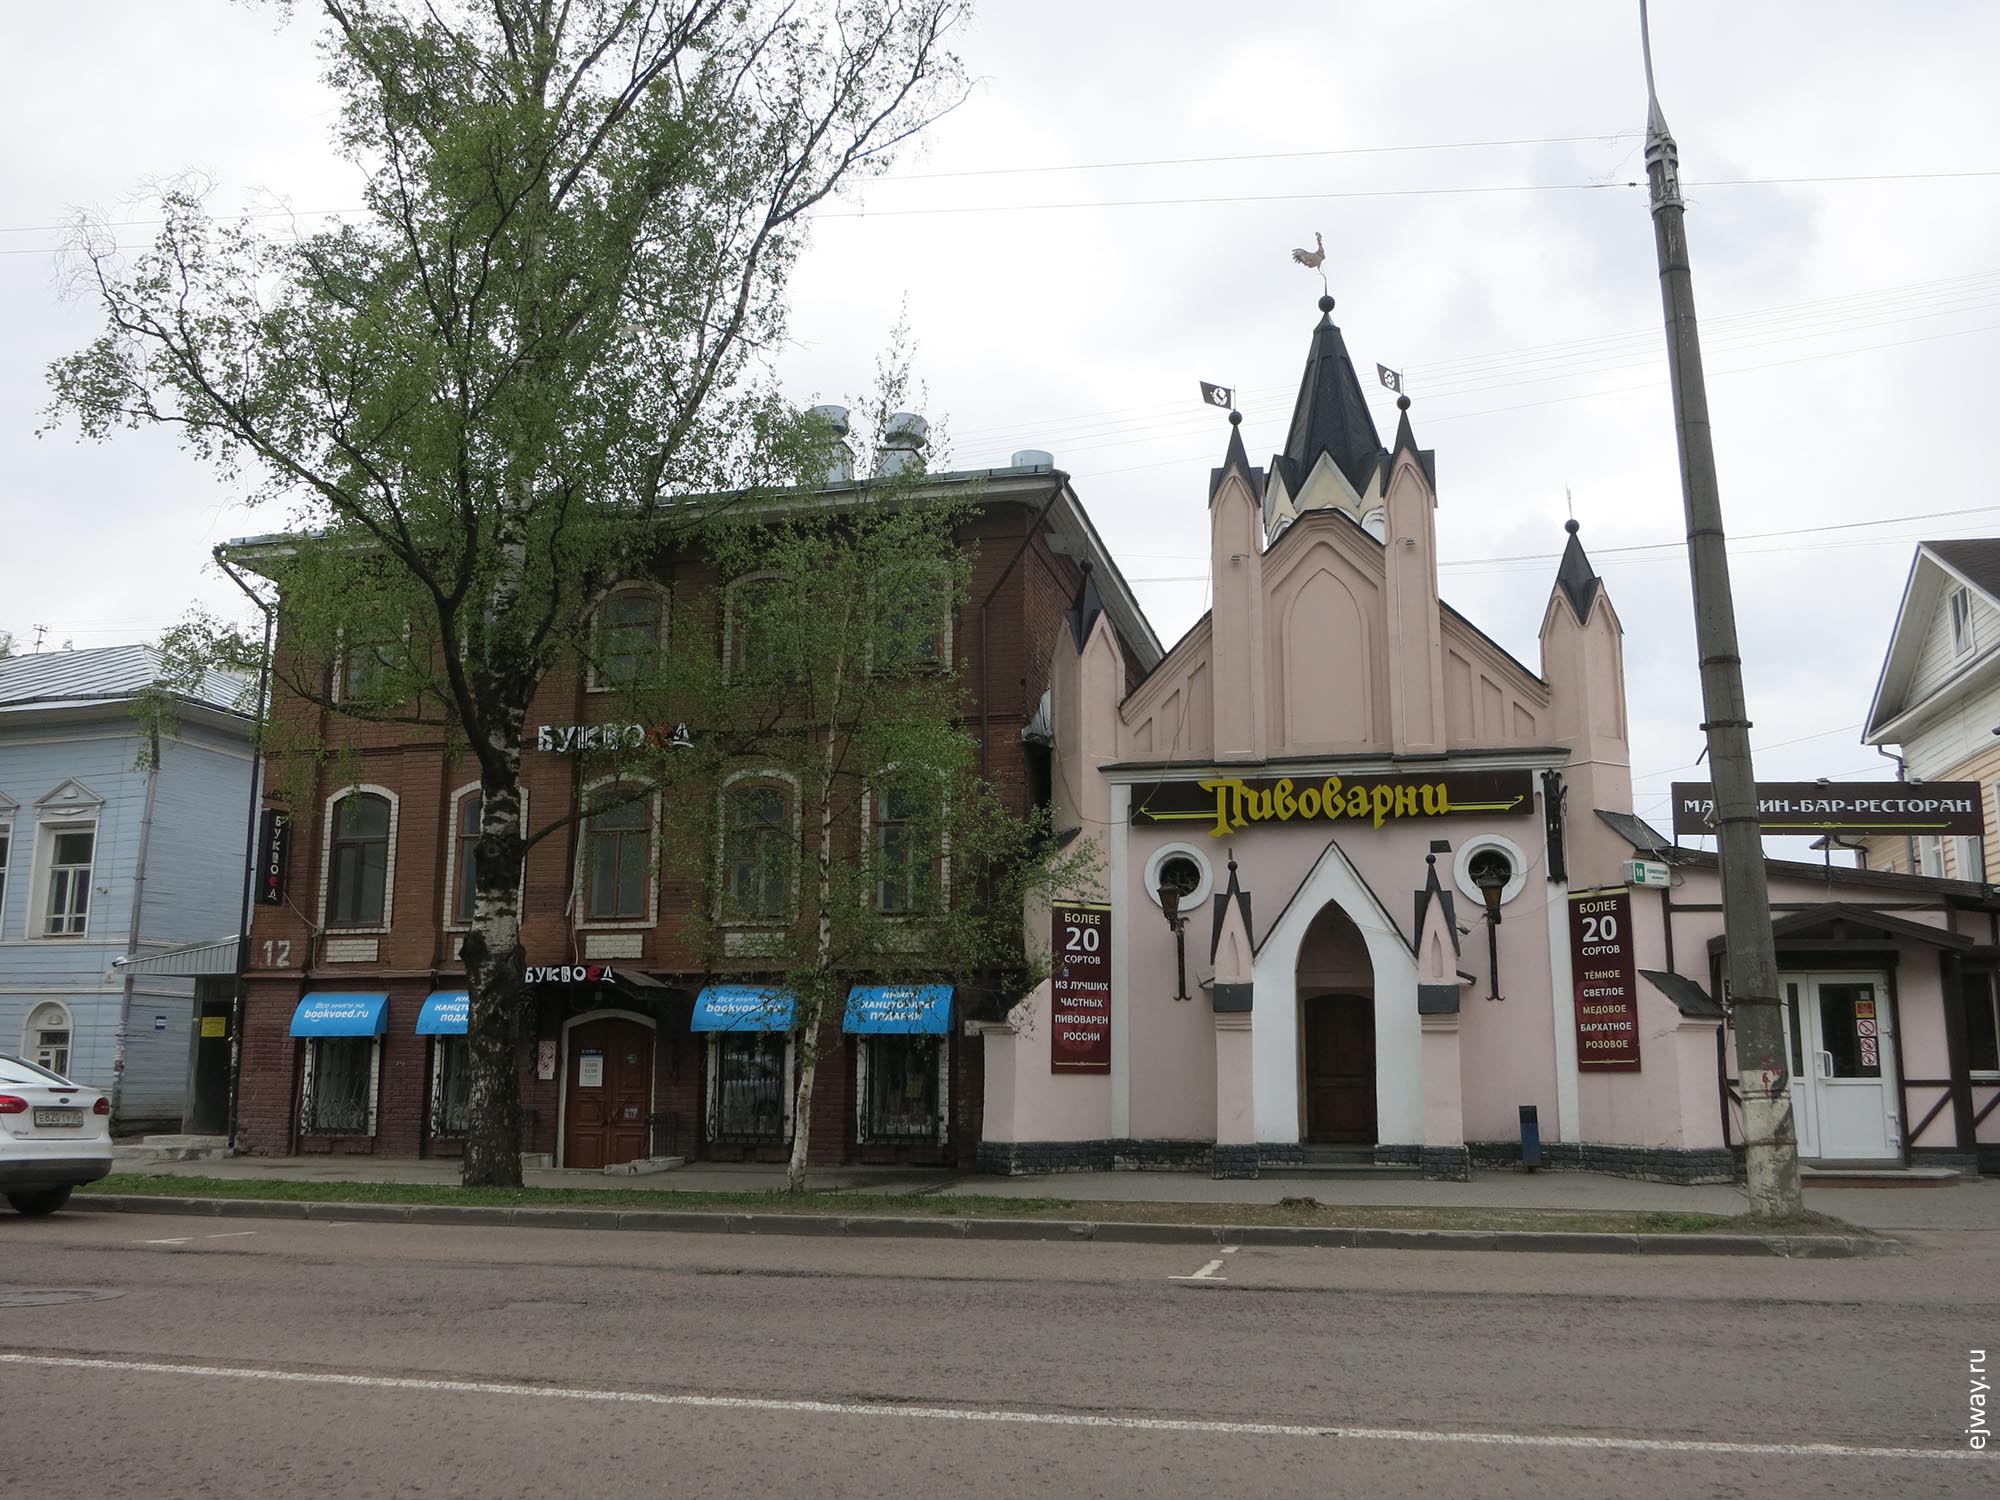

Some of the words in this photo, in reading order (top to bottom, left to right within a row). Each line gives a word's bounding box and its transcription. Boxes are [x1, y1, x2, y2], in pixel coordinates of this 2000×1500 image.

[1197, 775, 1450, 838] Пивоварни
[1683, 798, 1972, 814] МАИН-БАР-РЕСТОРАН
[1579, 900, 1617, 914] БОЛЕЕ
[1064, 912, 1101, 925] БОЛЕЕ
[1582, 915, 1618, 943] 20
[1065, 927, 1100, 952] 20
[263, 940, 290, 968] 12
[1582, 945, 1621, 956] СОРТОВ
[1064, 954, 1101, 965] СОРТОВ
[1055, 980, 1068, 990] ИЗ
[1070, 981, 1109, 991] ЛУЧШИХ
[1583, 986, 1625, 998] СВЕТЛОЕ
[1060, 997, 1103, 1008] ЧАСТНЫХ
[304, 1008, 369, 1019] bookvoed.ru
[1583, 1004, 1627, 1015] МЕДОВОЕ
[440, 1013, 469, 1023] ПОДА
[1055, 1015, 1109, 1025] ПИВОВАРЕН
[1580, 1021, 1632, 1032] БАРХАТНОЕ
[1063, 1031, 1101, 1041] РОССИИ
[1585, 1039, 1629, 1049] РОЗОВОЕ
